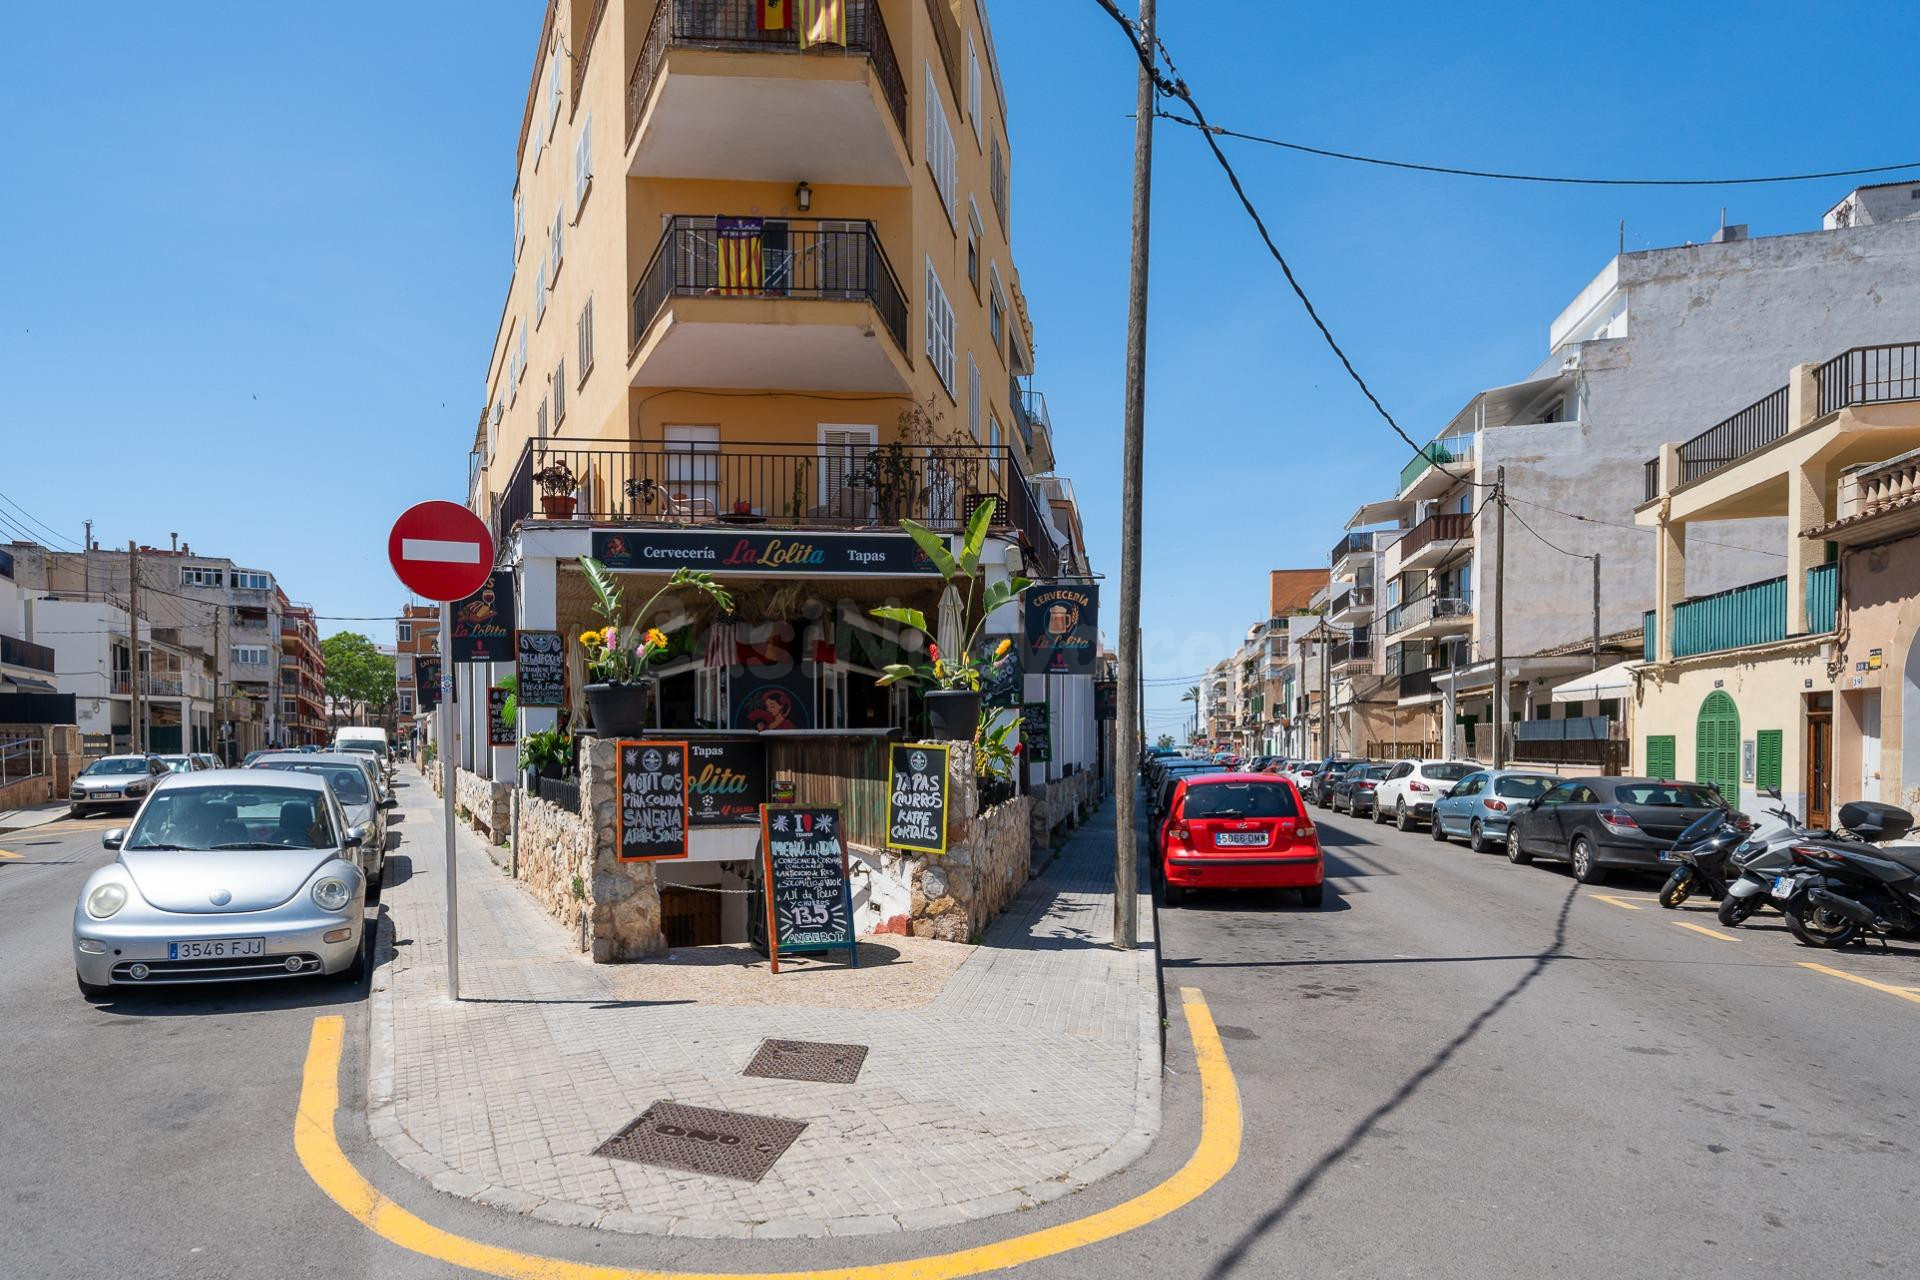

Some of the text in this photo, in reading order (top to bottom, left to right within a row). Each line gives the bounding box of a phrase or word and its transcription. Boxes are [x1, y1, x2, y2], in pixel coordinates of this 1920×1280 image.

[643, 539, 886, 567] Cervecería La Lolita Tapas
[1033, 590, 1090, 607] CERVECERÍA
[469, 624, 507, 638] Lolita
[1051, 635, 1089, 648] Lolita
[692, 746, 724, 758] Tapas
[622, 772, 683, 794] MOJITOS
[687, 763, 748, 794] olita
[895, 772, 940, 791] TAPAS
[646, 793, 684, 807] COLADA
[891, 791, 943, 808] CHURROS
[897, 809, 932, 825] KAFFE
[771, 836, 841, 857] MENÚ del DÍA
[791, 905, 829, 924] 13.5
[787, 932, 845, 943] ANGEBOT
[181, 941, 261, 957] 3546 FJJ
